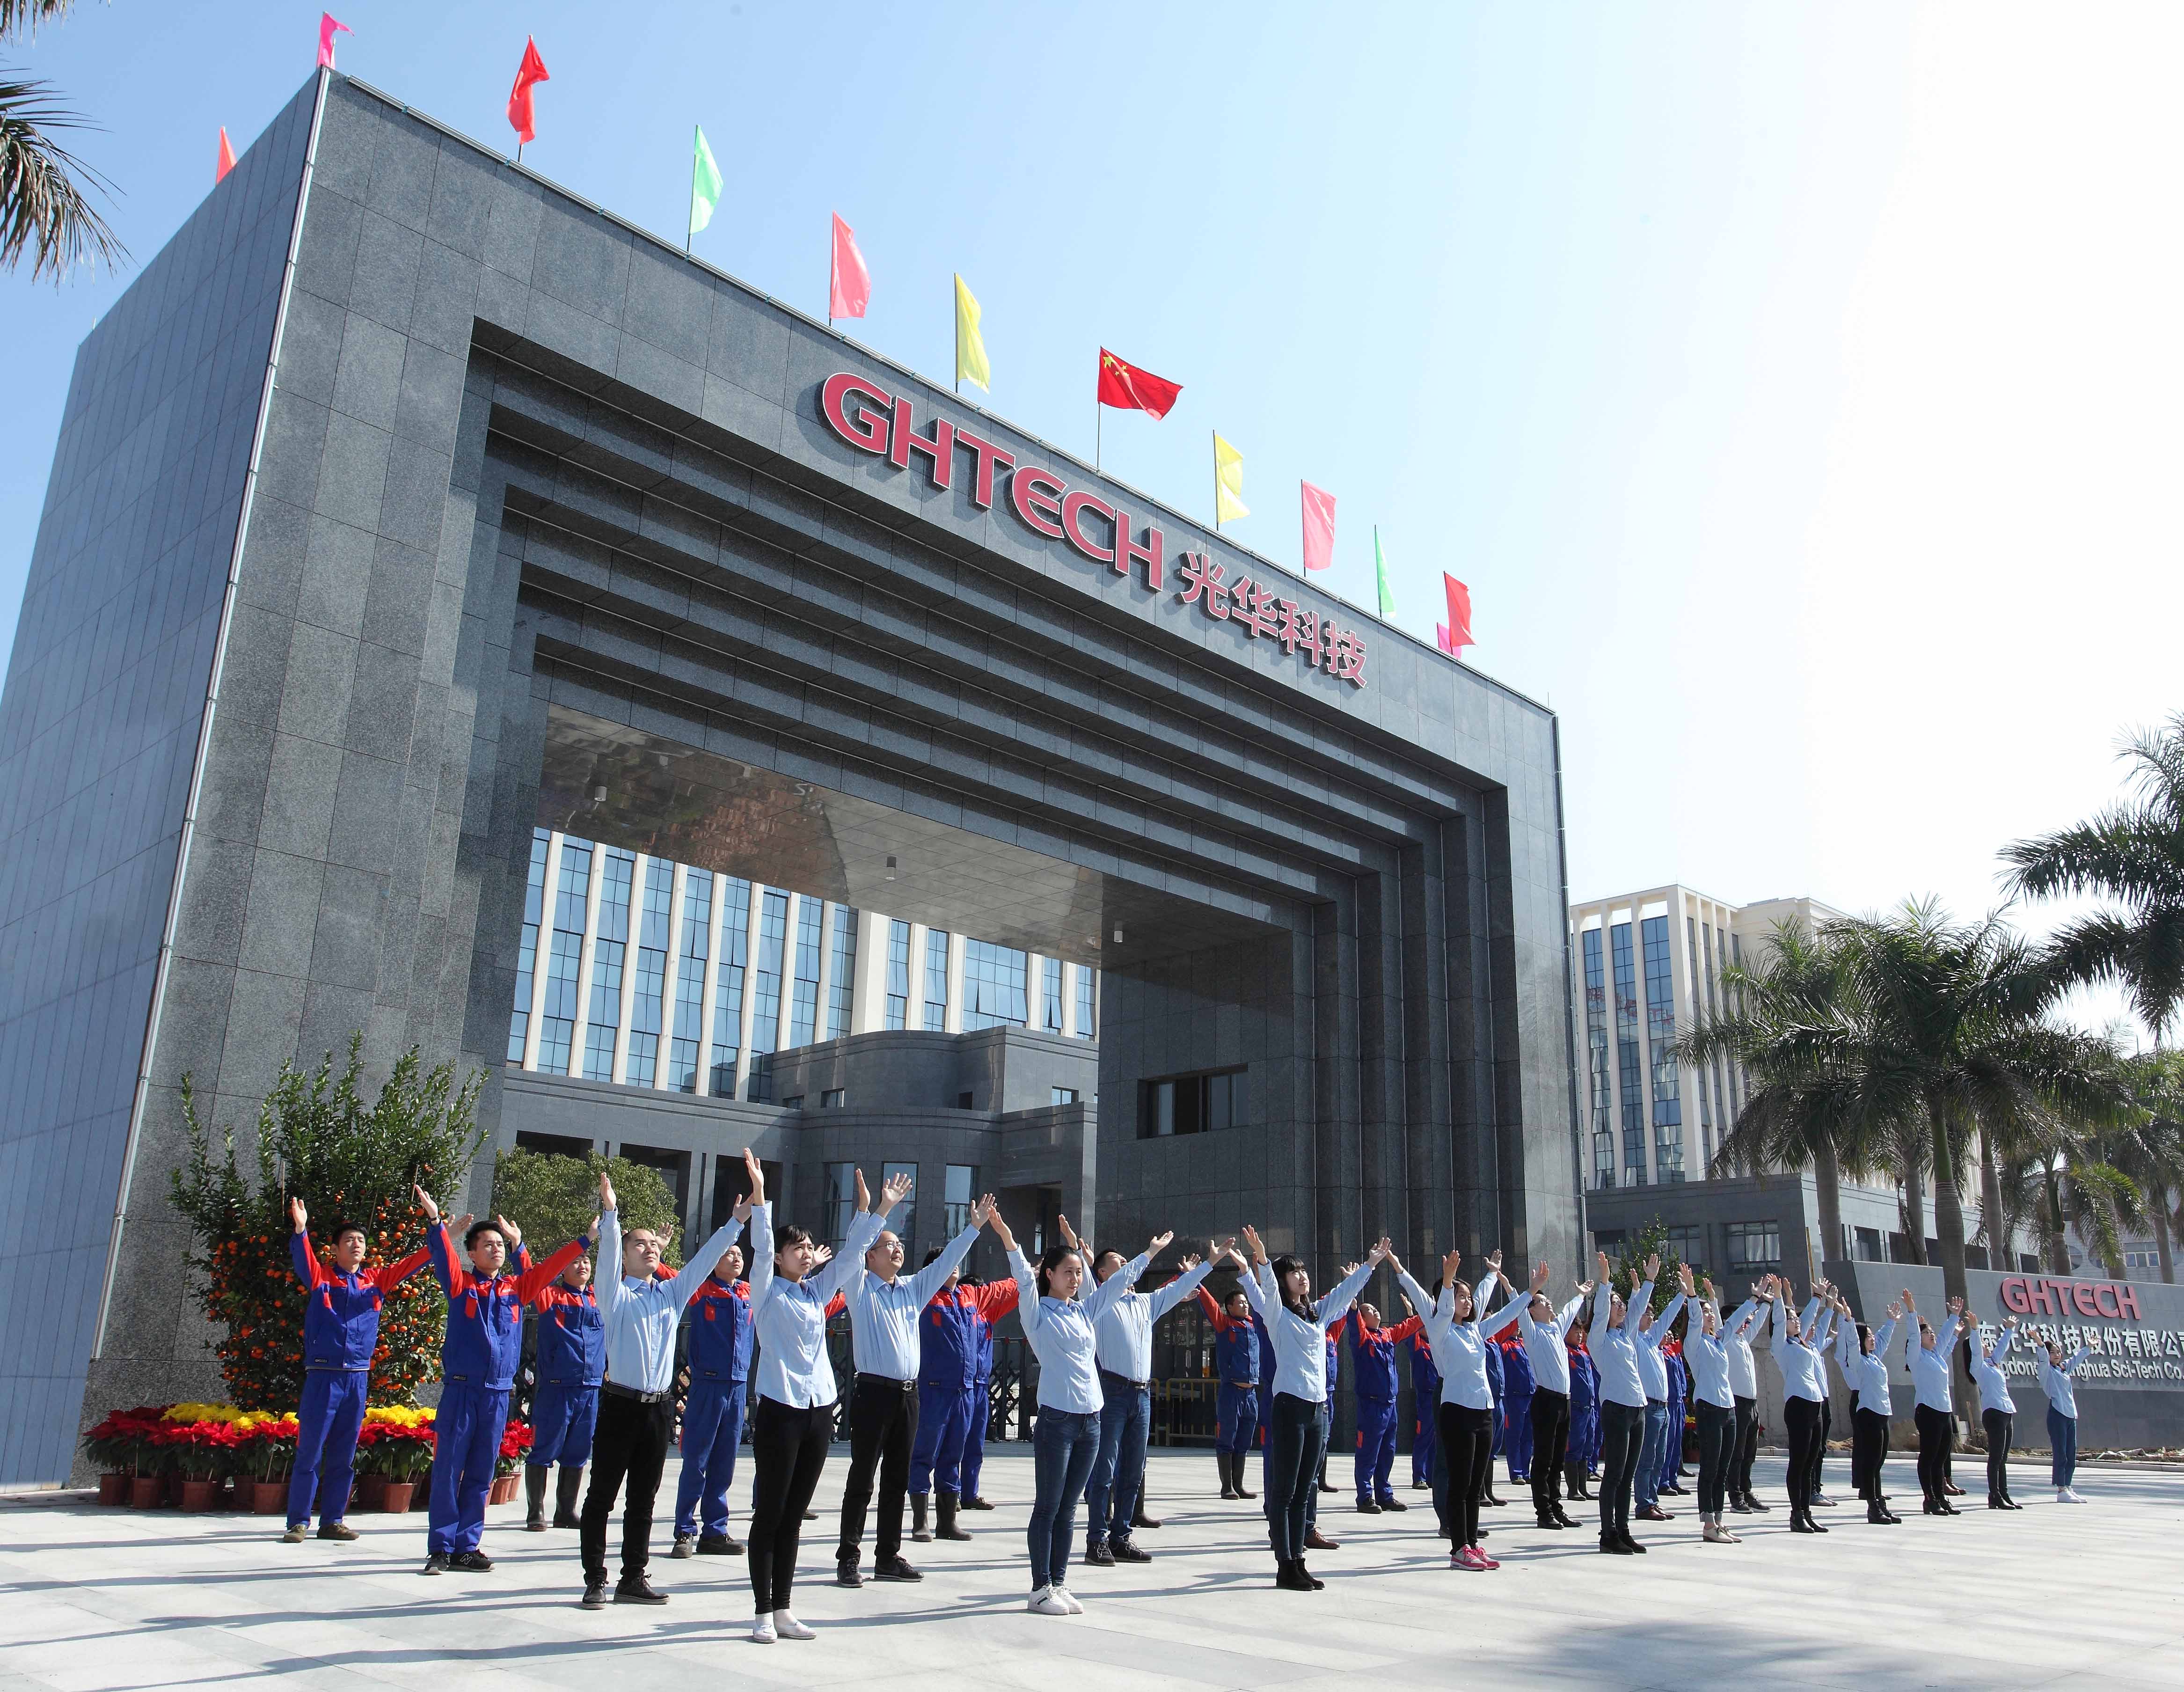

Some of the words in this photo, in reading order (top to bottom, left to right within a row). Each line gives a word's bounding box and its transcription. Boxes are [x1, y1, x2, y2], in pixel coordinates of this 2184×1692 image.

[821, 371, 1165, 592] GHTECH
[1180, 550, 1367, 689] 光华科技
[2001, 1277, 2142, 1319] GHTECH
[2111, 1359, 2163, 1379] Sci-Tech
